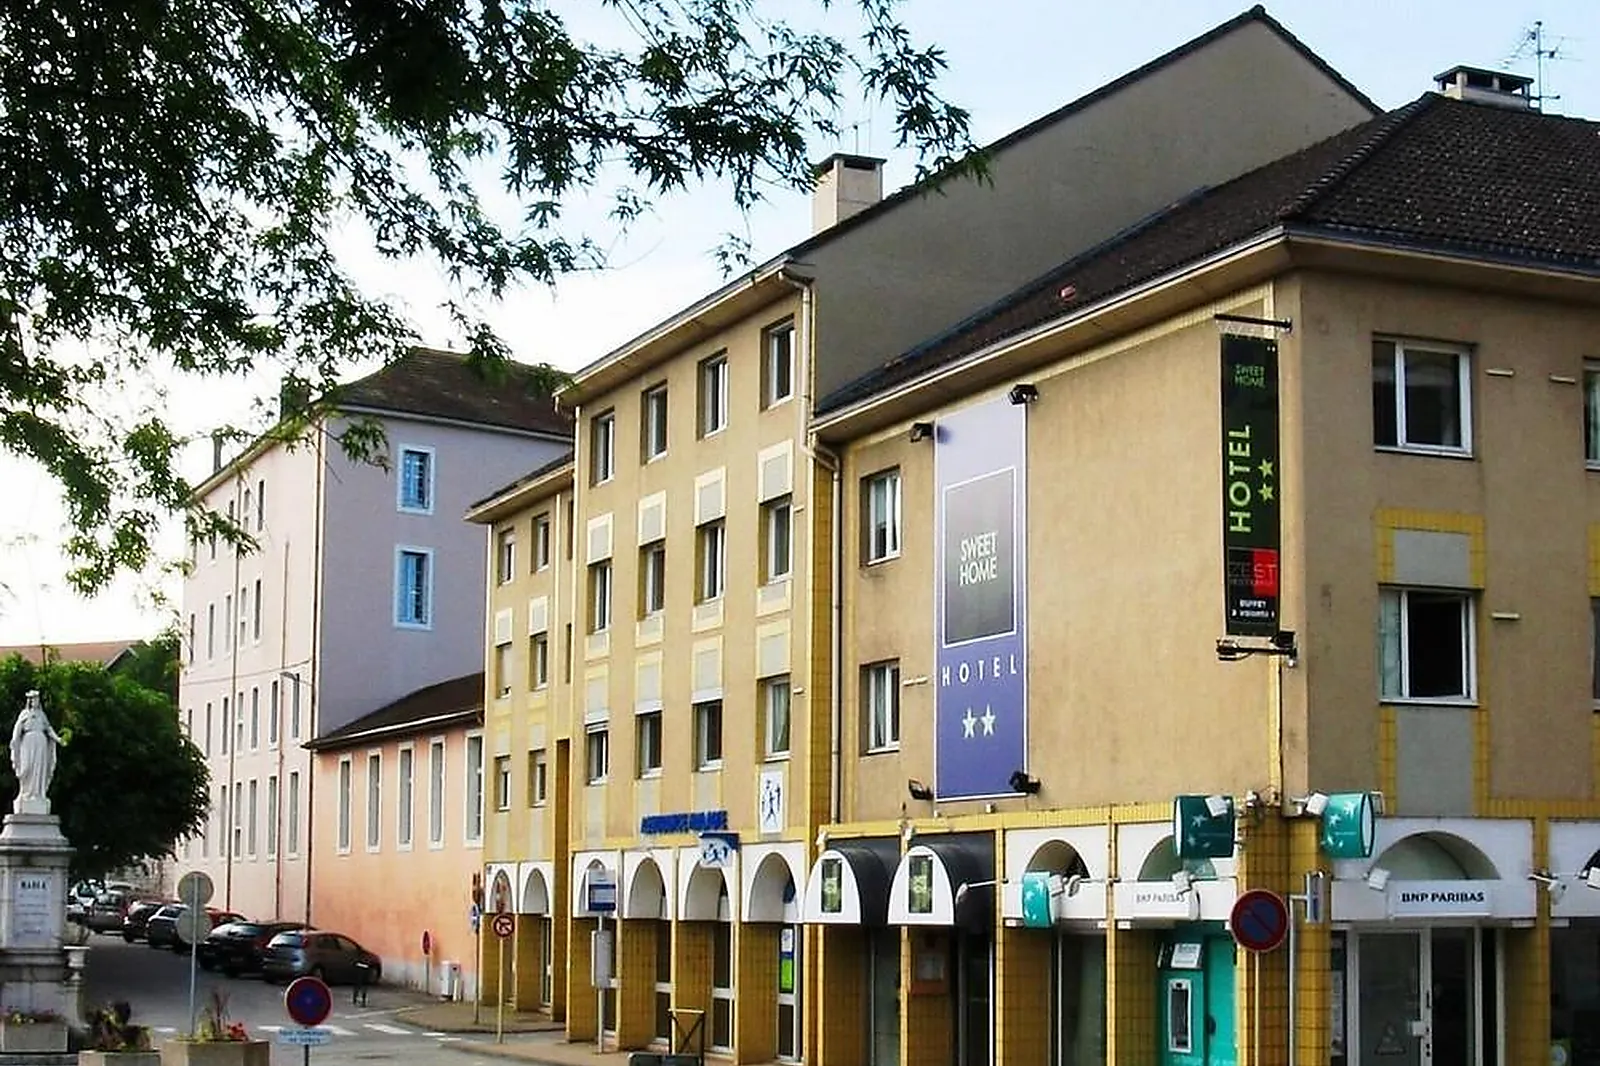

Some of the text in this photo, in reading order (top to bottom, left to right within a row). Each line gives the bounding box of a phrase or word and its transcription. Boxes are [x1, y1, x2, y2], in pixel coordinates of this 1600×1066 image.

[1228, 425, 1251, 532] HOTEL
[960, 531, 998, 562] SWEET
[960, 556, 997, 586] HOME
[941, 654, 1017, 687] HOTEL
[1401, 891, 1485, 903] BNP PARIBAS
